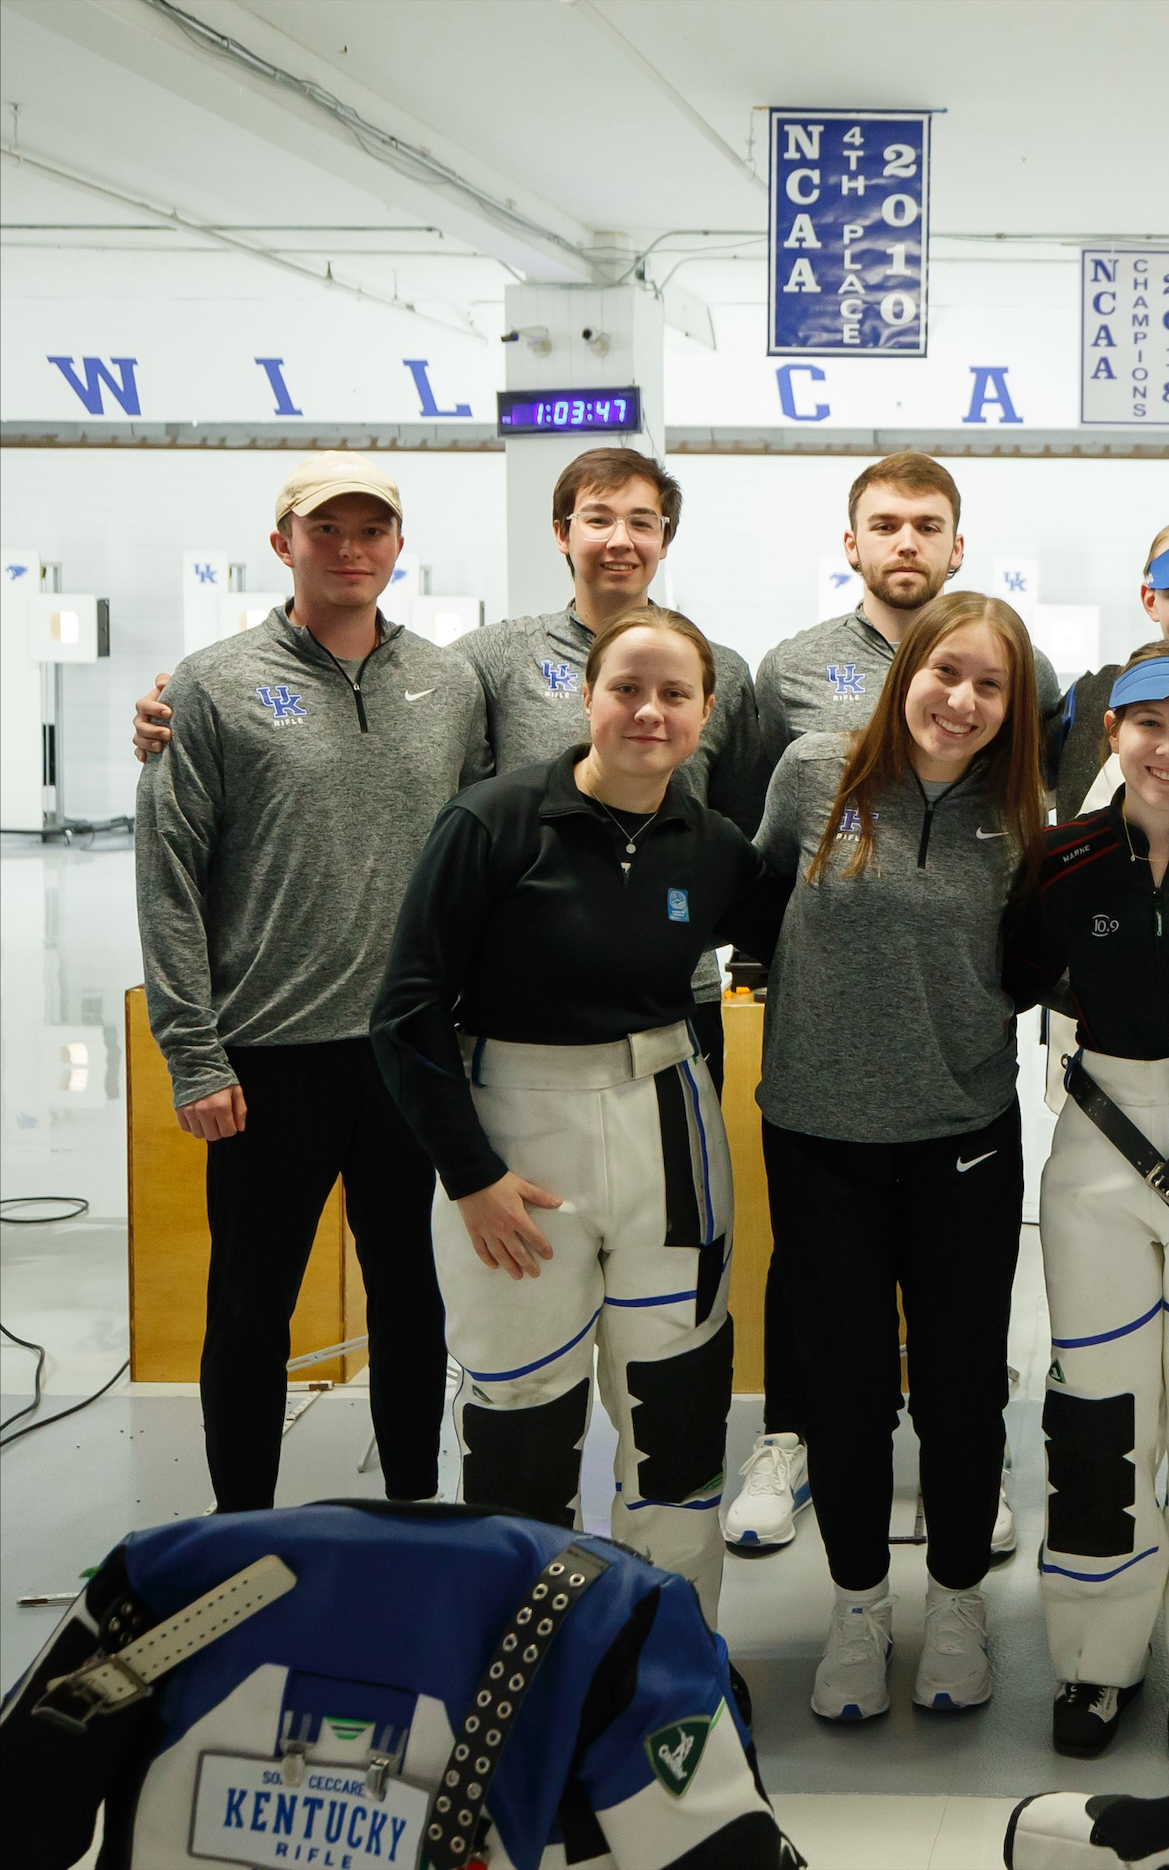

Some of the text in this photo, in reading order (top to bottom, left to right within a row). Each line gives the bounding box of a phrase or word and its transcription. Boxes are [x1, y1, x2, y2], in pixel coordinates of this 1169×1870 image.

[783, 125, 824, 293] NCAA
[838, 126, 865, 344] 4TH PLACE
[880, 144, 918, 325] 2010
[1090, 259, 1119, 379] NCAA
[1131, 259, 1149, 417] CHAMPIONS
[536, 399, 626, 425] 1:03:47
[541, 660, 578, 691] UK
[826, 663, 866, 694] UK
[256, 685, 307, 718] UK
[544, 691, 570, 699] RIFLE
[273, 717, 304, 728] RIFLE
[1062, 844, 1091, 863] MARNE
[1094, 918, 1119, 934] 10.9
[223, 1788, 407, 1862] KENTUCKY
[275, 1841, 352, 1869] RIFLE
